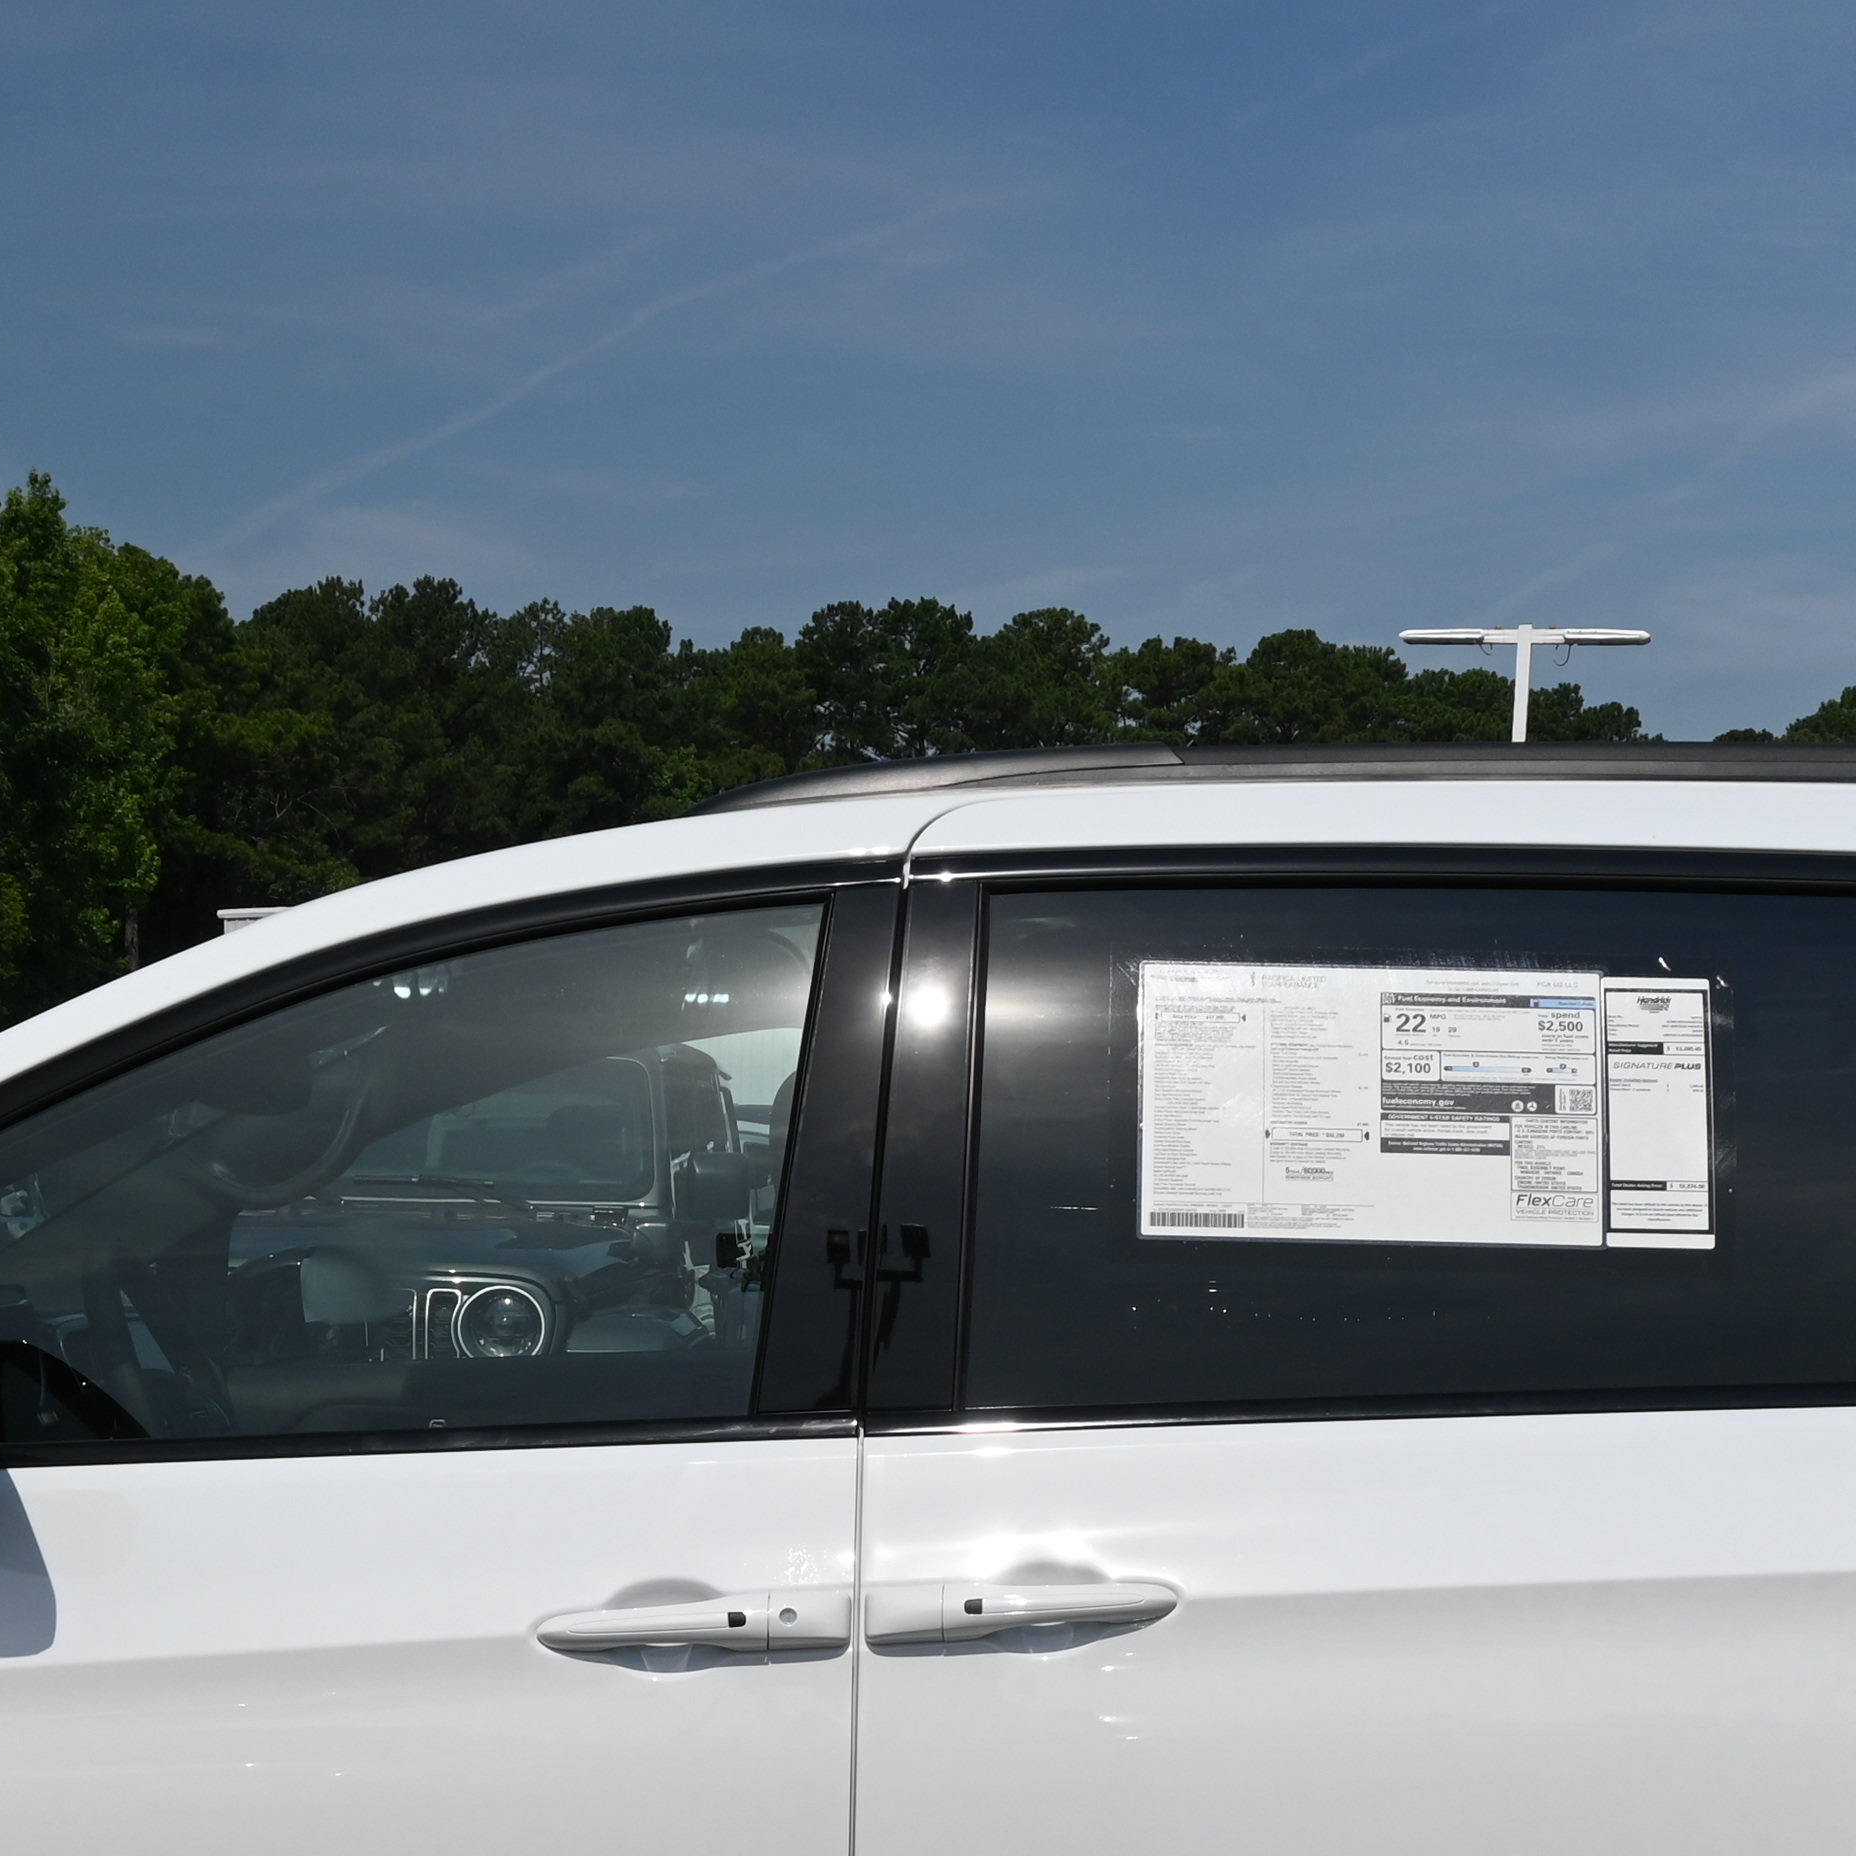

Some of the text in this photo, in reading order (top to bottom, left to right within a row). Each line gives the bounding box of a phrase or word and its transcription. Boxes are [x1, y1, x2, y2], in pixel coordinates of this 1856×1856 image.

[1551, 1012, 1581, 1020] spend
[1396, 1013, 1426, 1033] 22
[1538, 1020, 1583, 1032] $2,500
[1385, 1062, 1431, 1075] $2,100
[1613, 1062, 1673, 1070] SIGNATURE
[1382, 1096, 1455, 1107] fueleconomy.gov
[1516, 1193, 1594, 1208] FlexCare
